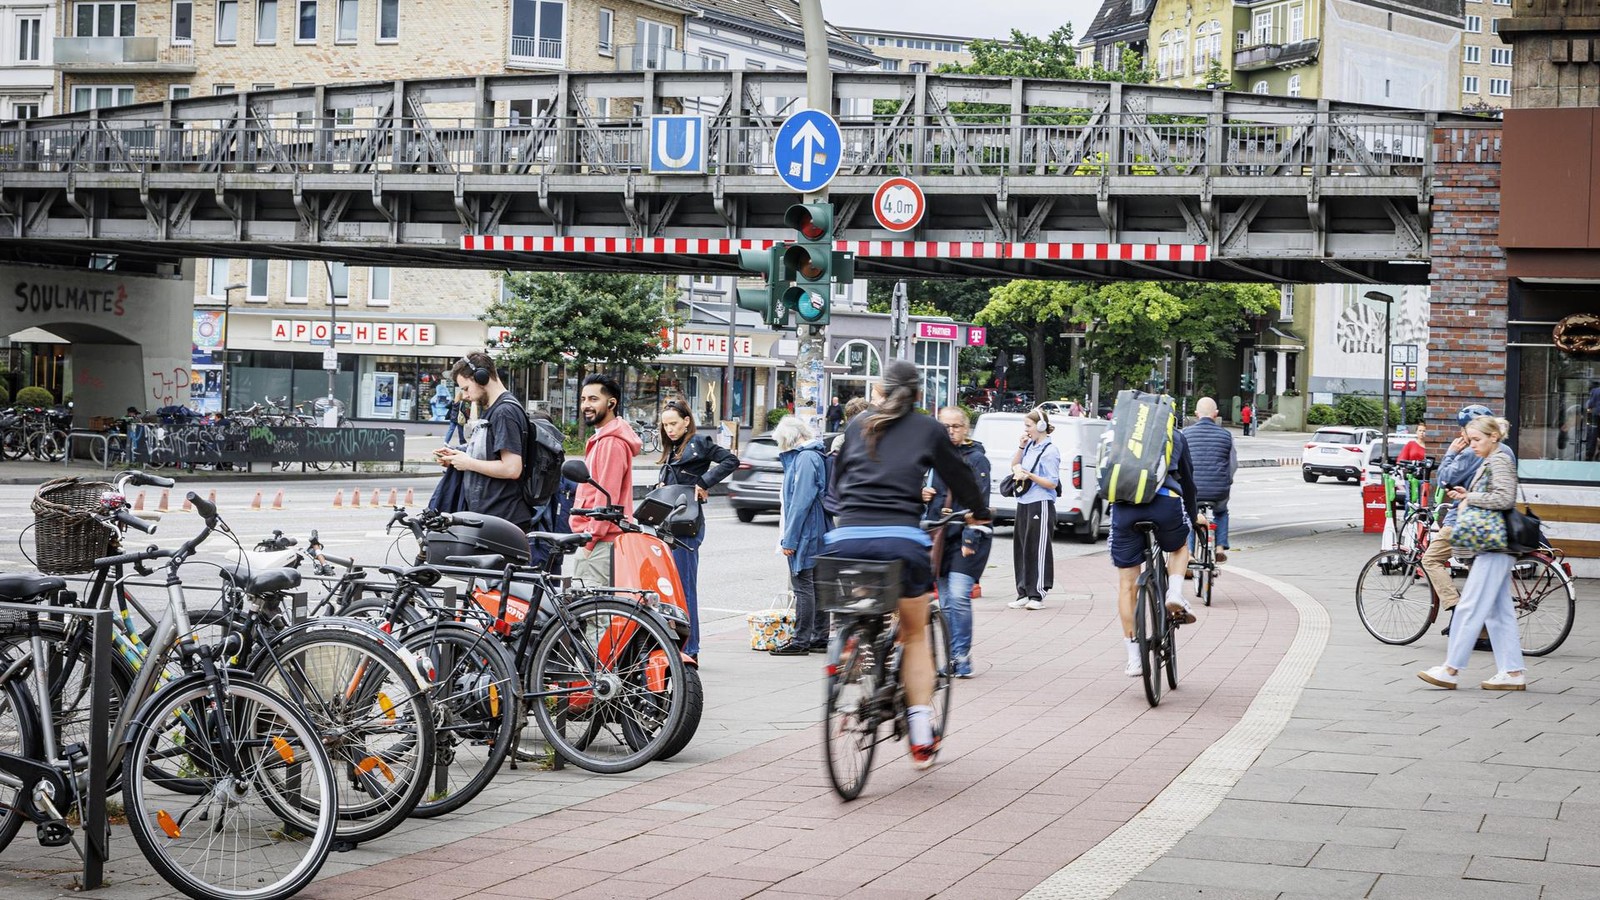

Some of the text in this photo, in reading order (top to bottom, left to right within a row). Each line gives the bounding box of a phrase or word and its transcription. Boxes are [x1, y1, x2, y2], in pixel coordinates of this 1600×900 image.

[658, 120, 695, 168] U
[276, 324, 428, 341] APOTHEKE
[971, 330, 982, 343] T
[683, 337, 750, 353] OTHEKE
